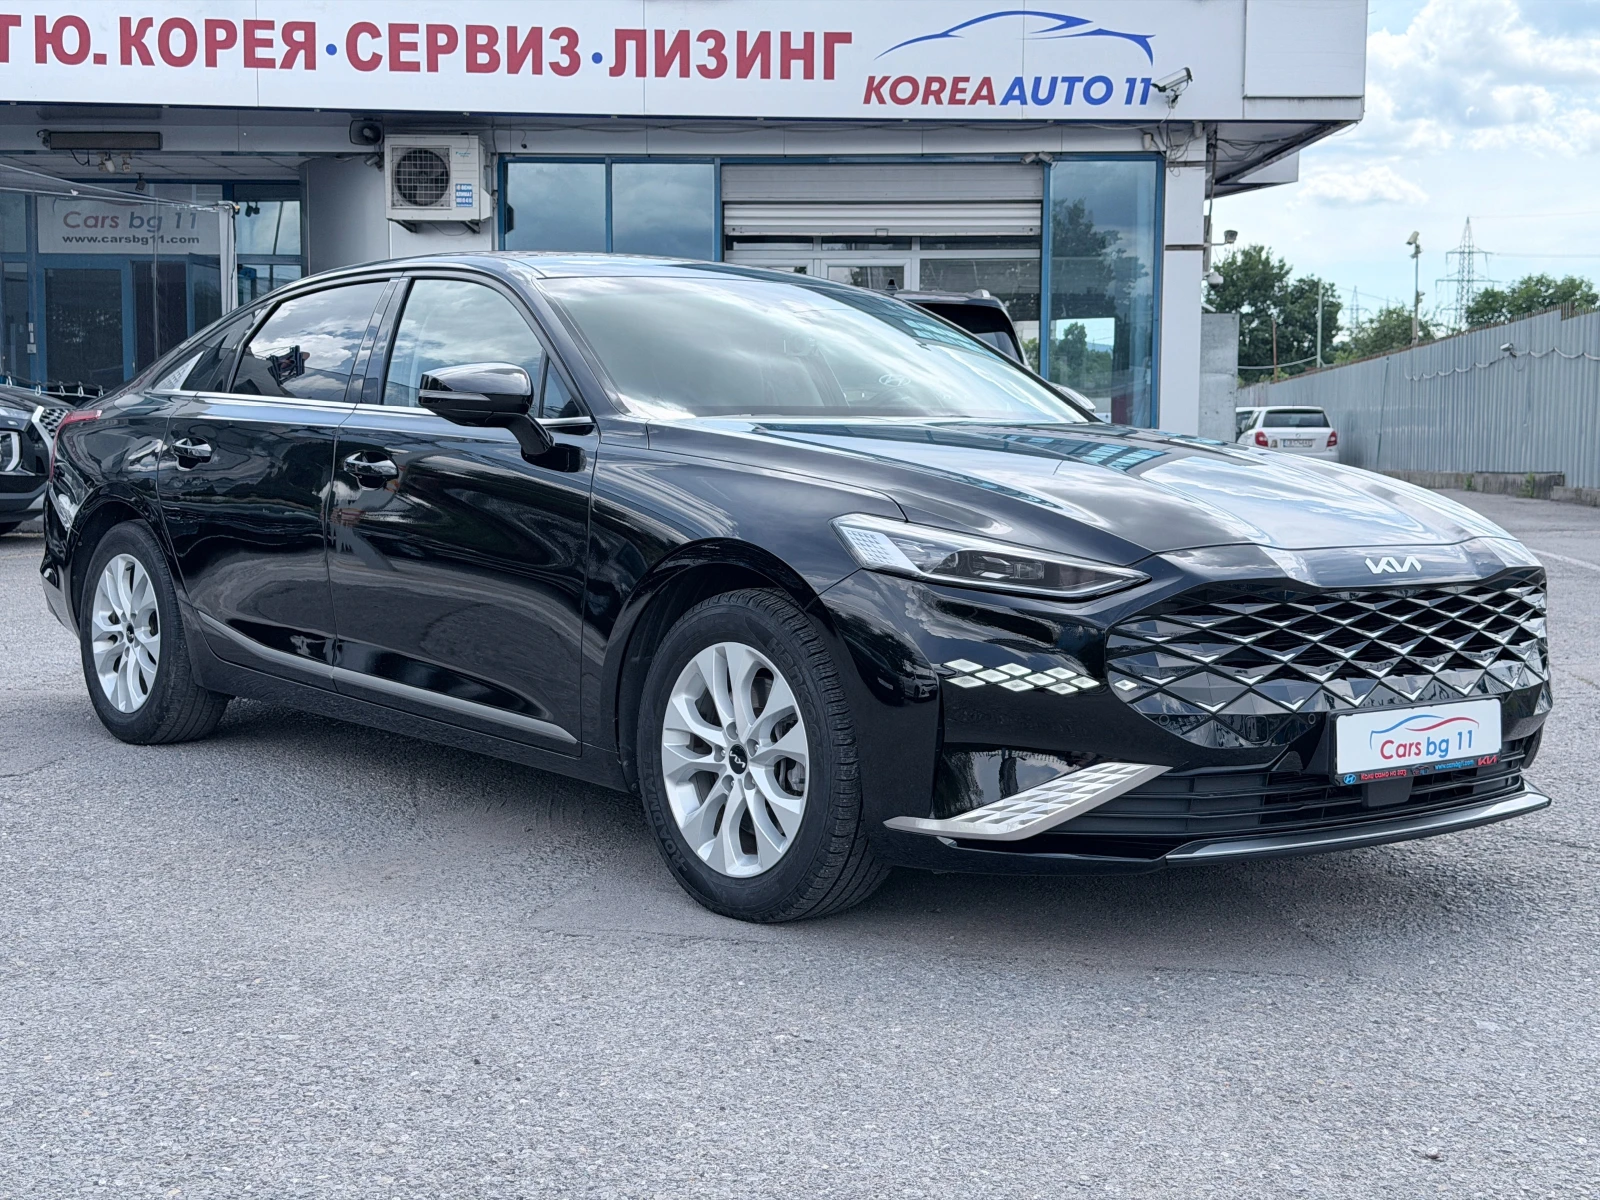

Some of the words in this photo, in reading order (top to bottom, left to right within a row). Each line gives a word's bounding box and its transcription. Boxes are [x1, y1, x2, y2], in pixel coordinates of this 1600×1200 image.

[119, 16, 317, 71] КОРЕЯ
[345, 21, 582, 77] СЕРВИЗ
[609, 28, 853, 81] ЛИЗИНГ
[862, 75, 997, 106] KOREA
[1000, 75, 1114, 106] AUTO
[1124, 77, 1152, 106] 11
[63, 211, 120, 229] Cars
[128, 211, 163, 233] bg
[175, 212, 197, 229] 11
[62, 234, 200, 246] www.carsbg11.com
[1364, 555, 1422, 575] KIA
[1380, 739, 1422, 760] Cars
[1426, 736, 1450, 759] bg
[1457, 729, 1473, 750] 11
[1477, 755, 1497, 766] KIA
